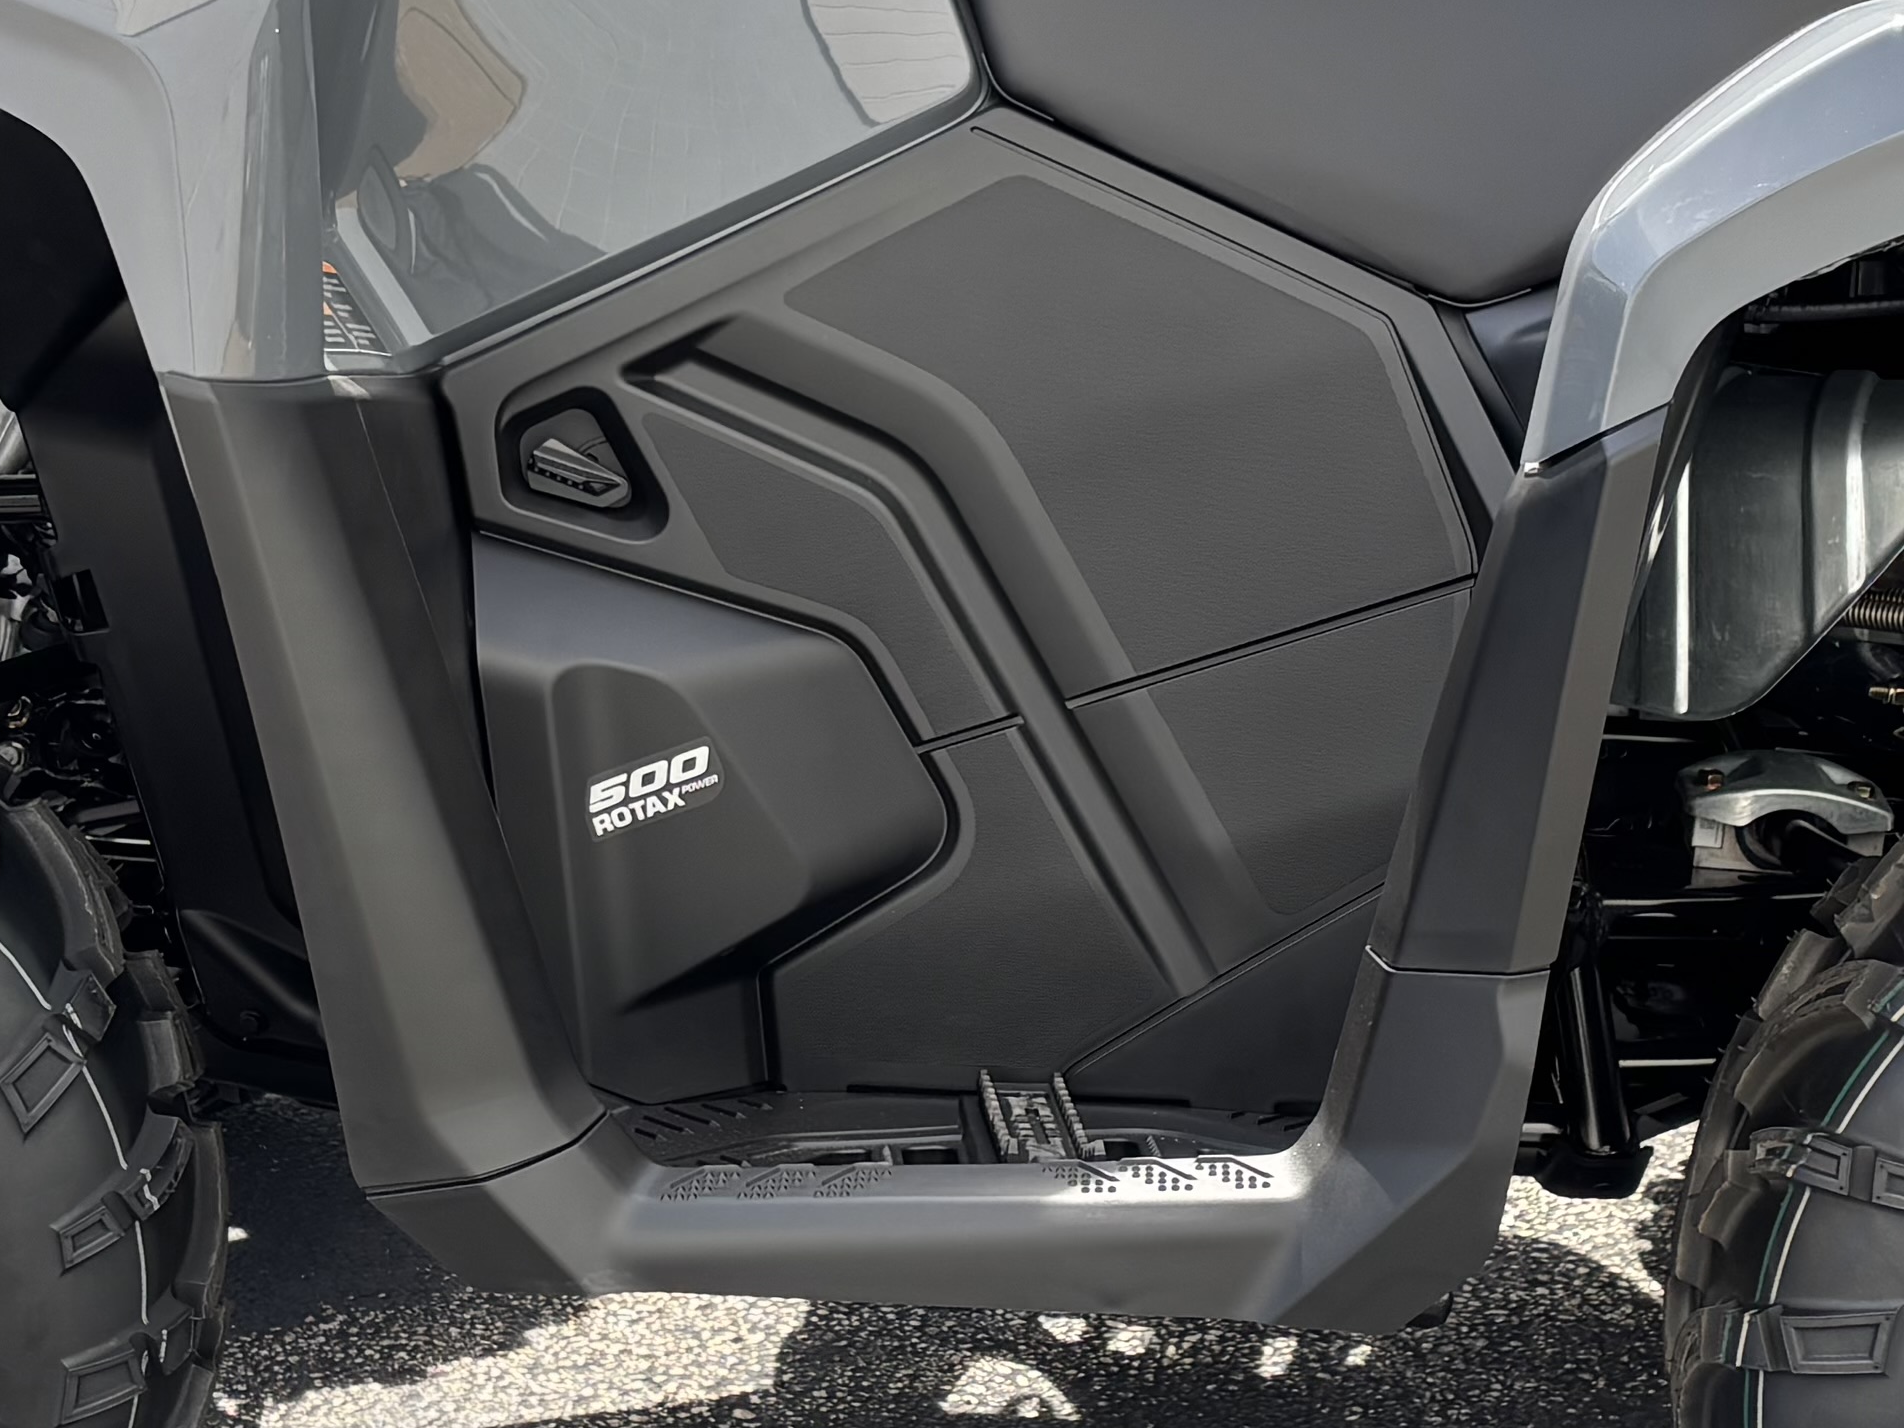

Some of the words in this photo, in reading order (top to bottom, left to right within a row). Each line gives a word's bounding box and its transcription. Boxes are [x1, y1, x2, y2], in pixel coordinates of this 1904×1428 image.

[589, 745, 710, 813] 500
[592, 788, 686, 837] ROTAX
[681, 773, 719, 794] POWER
